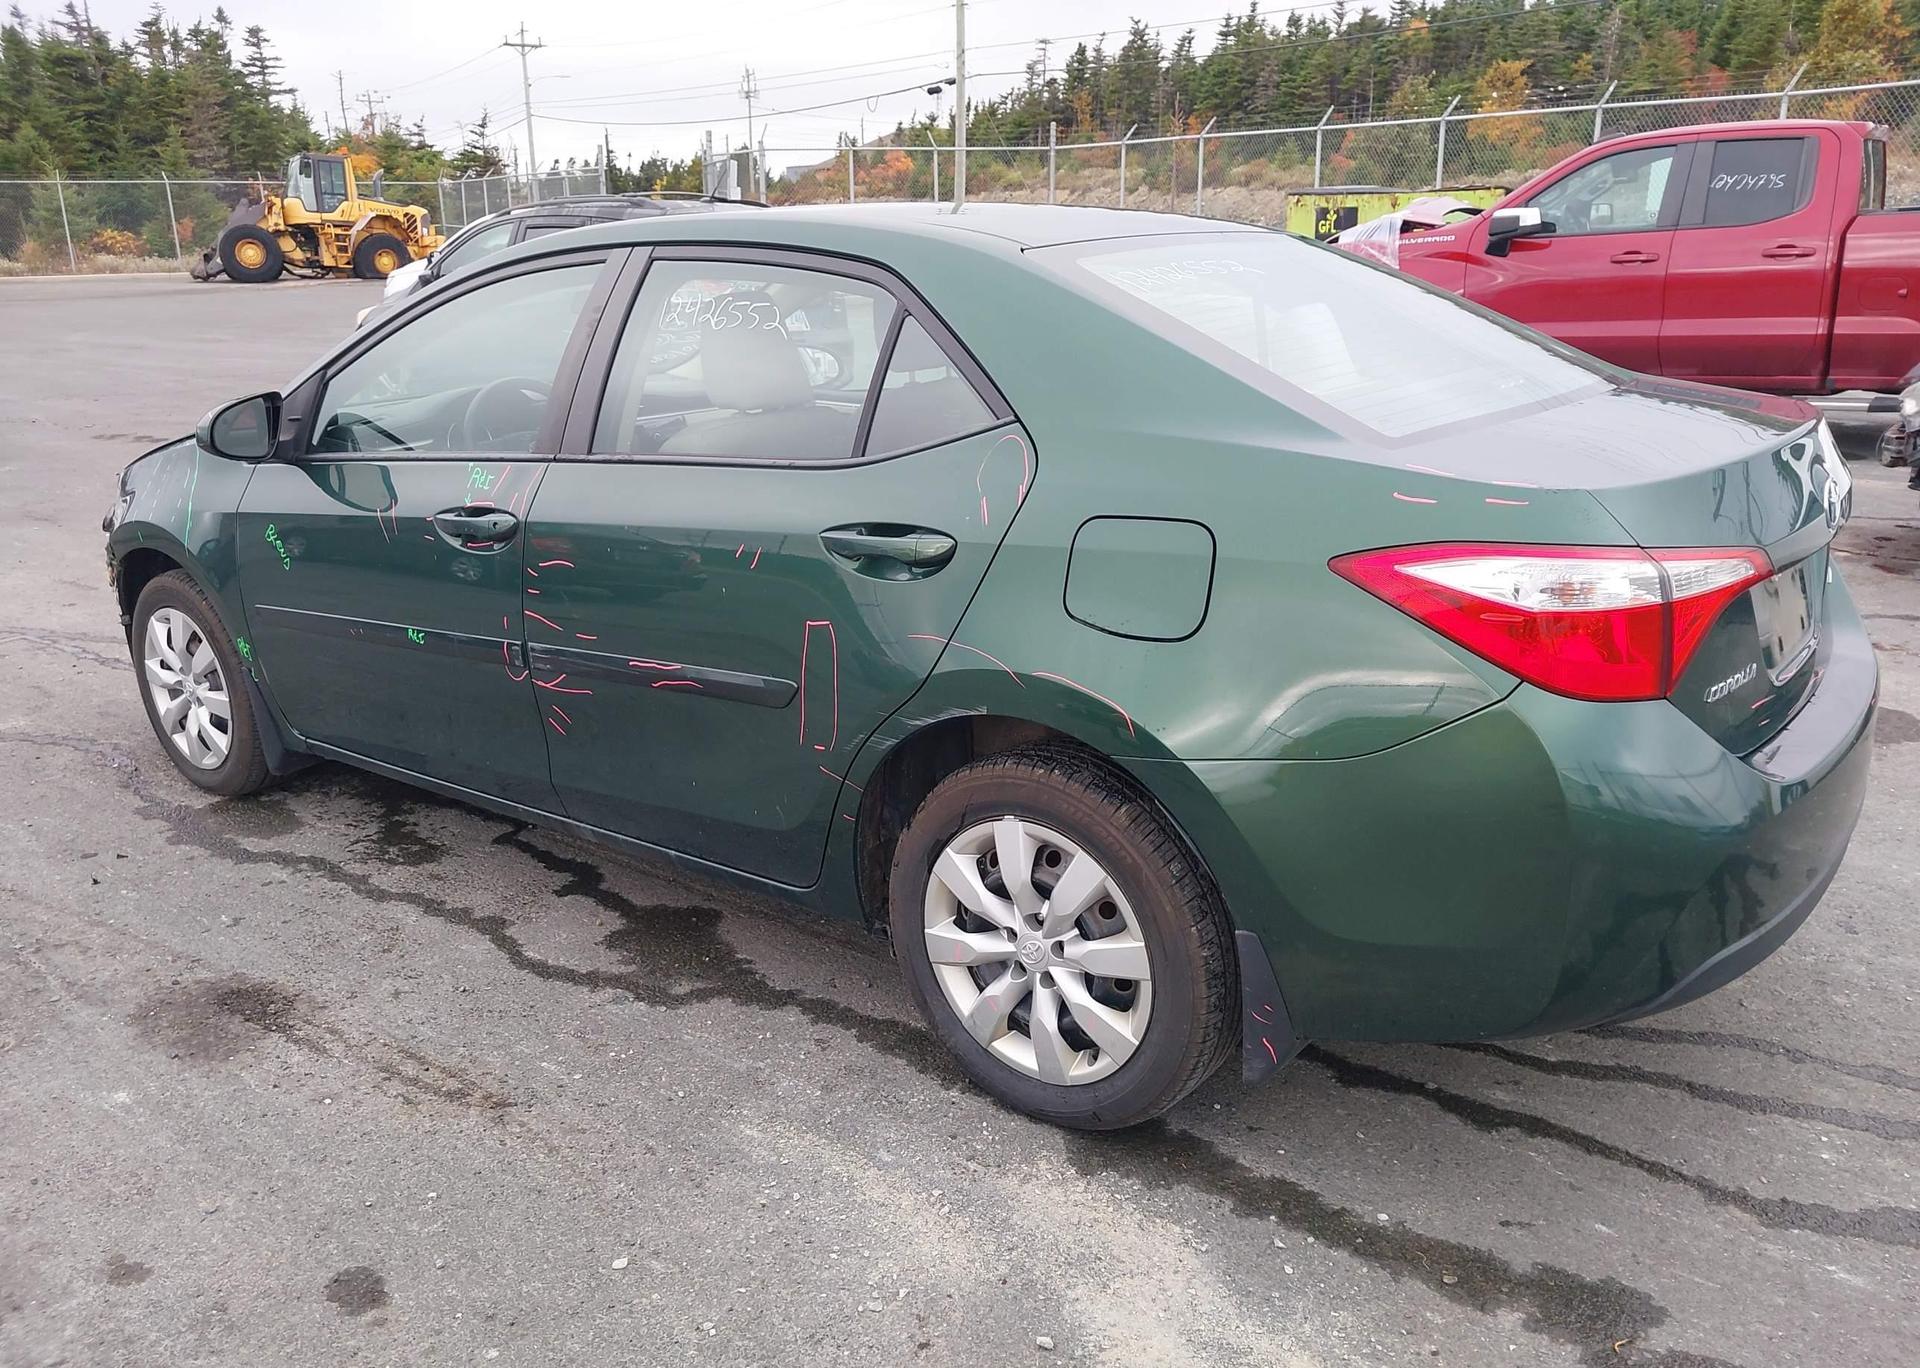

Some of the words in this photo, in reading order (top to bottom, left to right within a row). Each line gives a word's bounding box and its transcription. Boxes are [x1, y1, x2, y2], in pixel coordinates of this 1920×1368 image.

[370, 207, 400, 215] VOLVO
[1318, 217, 1336, 233] GFL
[1395, 235, 1456, 245] SILVERADO
[658, 293, 788, 340] 12426552
[1703, 662, 1757, 702] COROLLA
